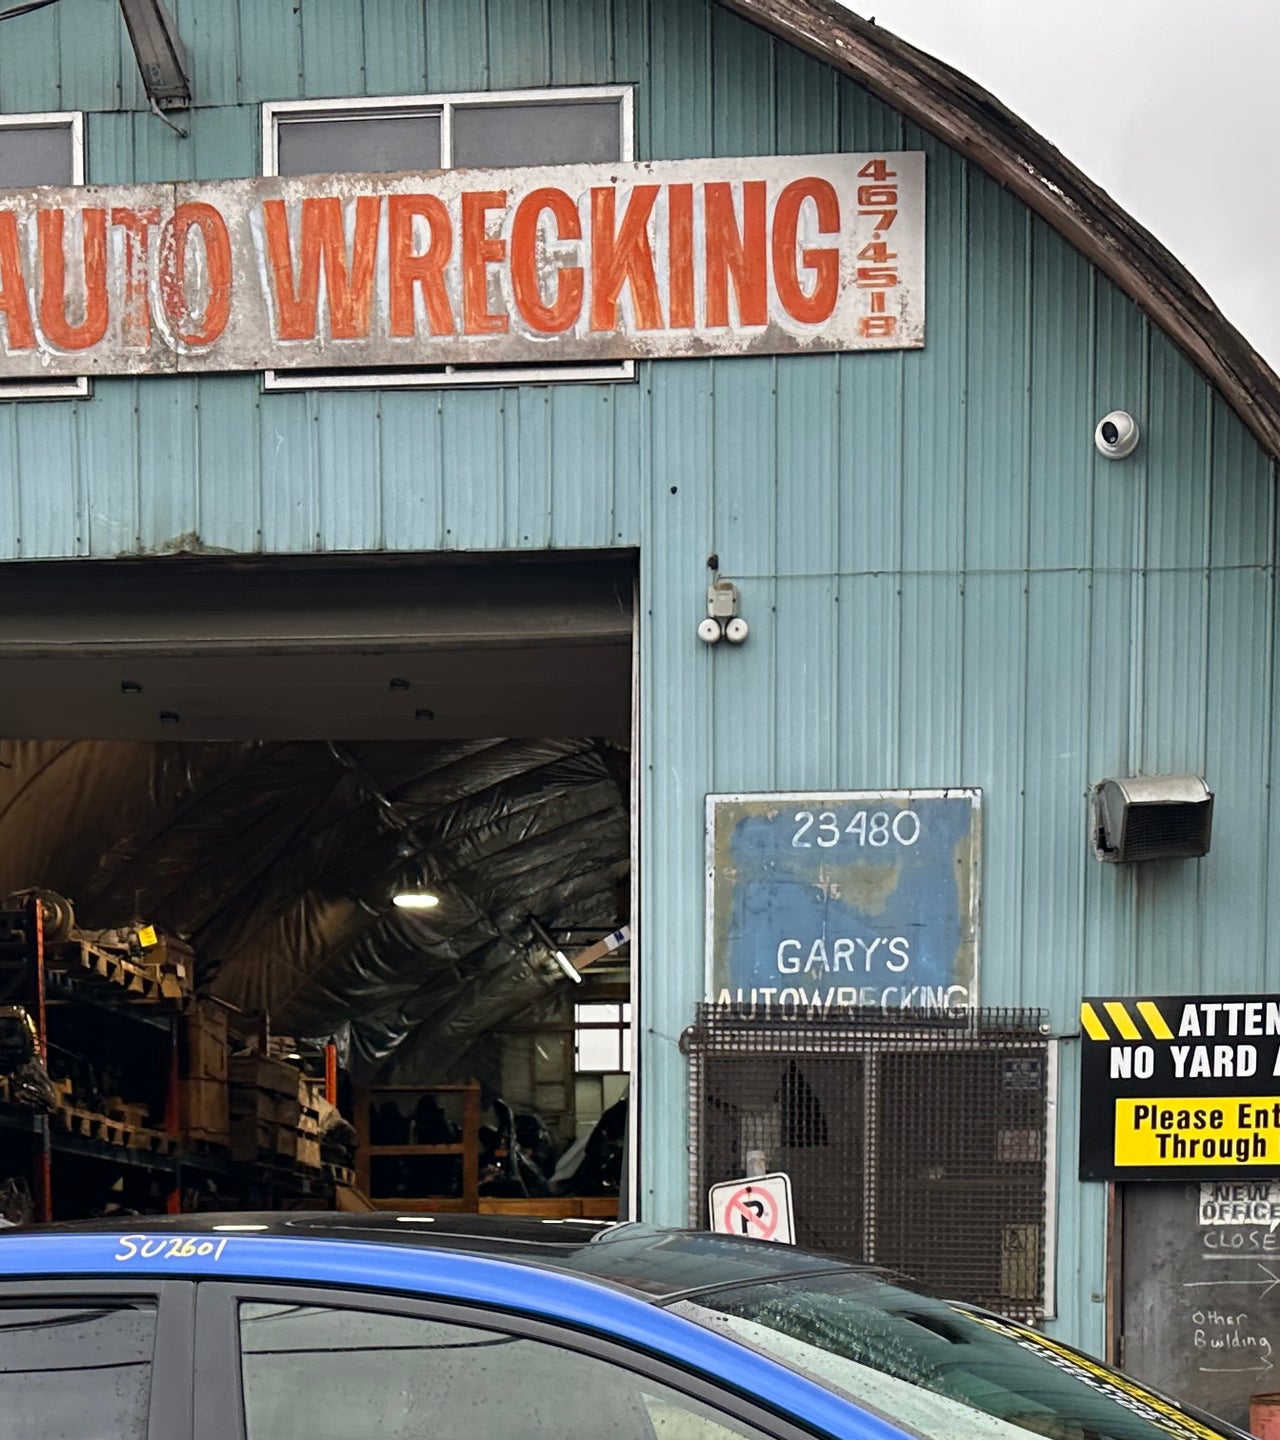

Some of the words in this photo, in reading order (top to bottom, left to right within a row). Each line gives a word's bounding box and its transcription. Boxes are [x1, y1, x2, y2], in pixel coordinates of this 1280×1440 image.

[262, 177, 841, 341] WRECKING
[791, 809, 921, 849] 23480
[776, 936, 911, 974] GARY'S
[1110, 1045, 1155, 1079] NO
[1171, 1044, 1257, 1078] YARD
[1133, 1105, 1224, 1131] Please
[1156, 1132, 1267, 1163] Through
[1215, 1183, 1270, 1201] NEW
[115, 1234, 228, 1262] SU2601
[1192, 1310, 1248, 1326] Other
[1194, 1329, 1272, 1358] Building
